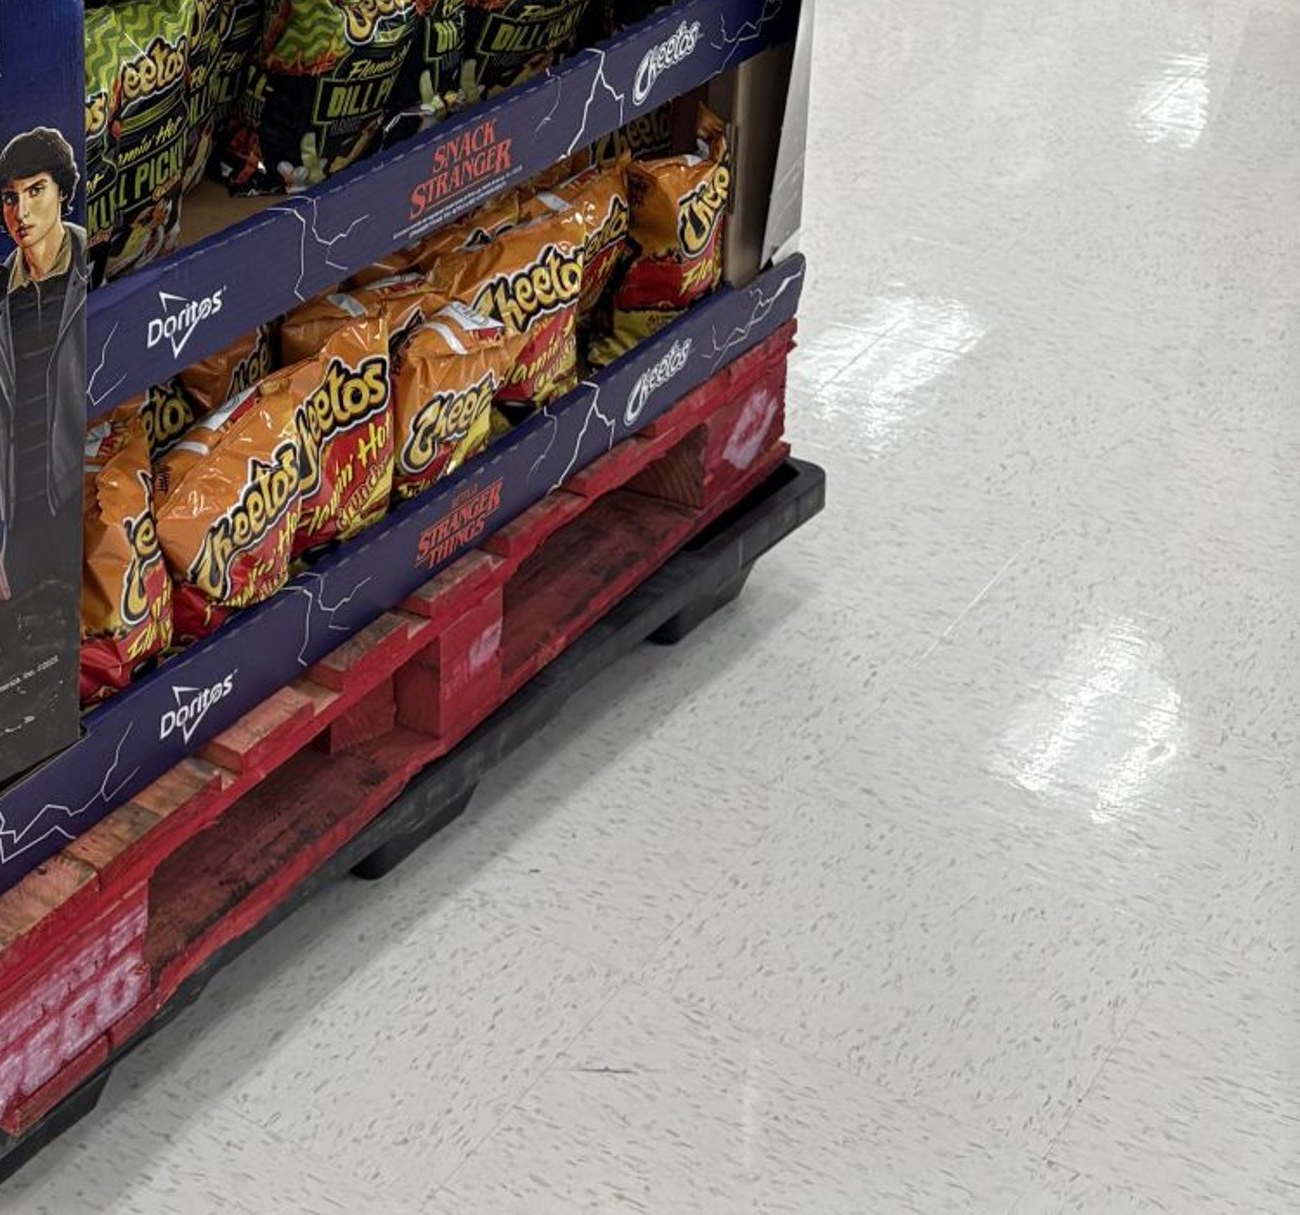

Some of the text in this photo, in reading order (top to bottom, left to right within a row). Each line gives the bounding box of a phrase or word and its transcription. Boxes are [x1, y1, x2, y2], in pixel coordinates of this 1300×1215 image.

[327, 81, 371, 118] DILL
[632, 20, 701, 106] Cheetos
[408, 138, 513, 220] STRANGER
[432, 118, 497, 174] SNACK
[678, 166, 731, 258] Chee
[147, 290, 224, 352] Doritos
[625, 337, 693, 427] Cheetos
[415, 480, 504, 563] STRANGER
[160, 678, 235, 741] Doritos
